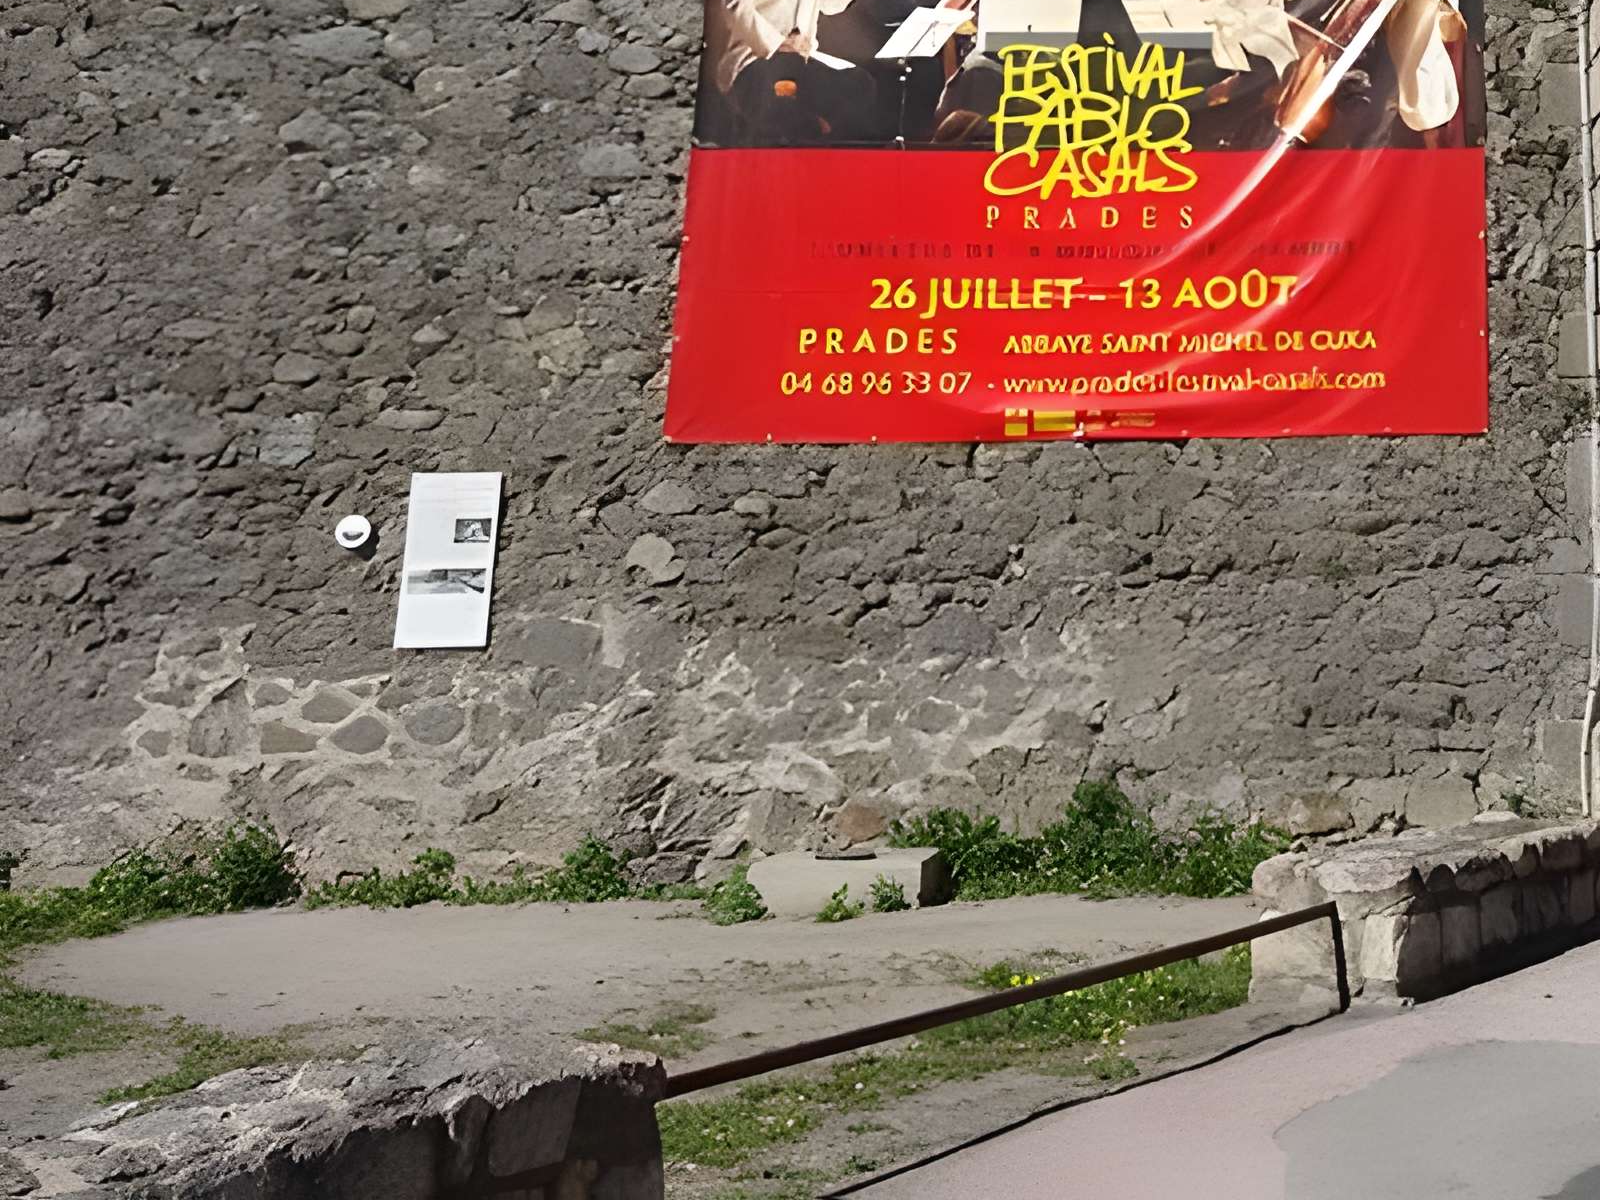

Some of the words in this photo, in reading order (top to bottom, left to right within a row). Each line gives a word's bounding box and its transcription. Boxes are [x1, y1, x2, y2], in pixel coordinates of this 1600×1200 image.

[988, 87, 1194, 154] PABLO
[983, 142, 1199, 201] CASALS
[985, 204, 1194, 230] PRADES
[869, 277, 918, 310] 26
[919, 276, 1084, 320] JUILLET
[1118, 277, 1163, 310] 13
[1171, 268, 1299, 310] AOÛT
[798, 327, 959, 355] PRADES
[1002, 333, 1095, 355] ABBAYE
[780, 371, 813, 396] 04
[820, 372, 853, 396] 68
[861, 371, 893, 395] 96
[901, 371, 932, 396] 33
[938, 371, 973, 396] 07
